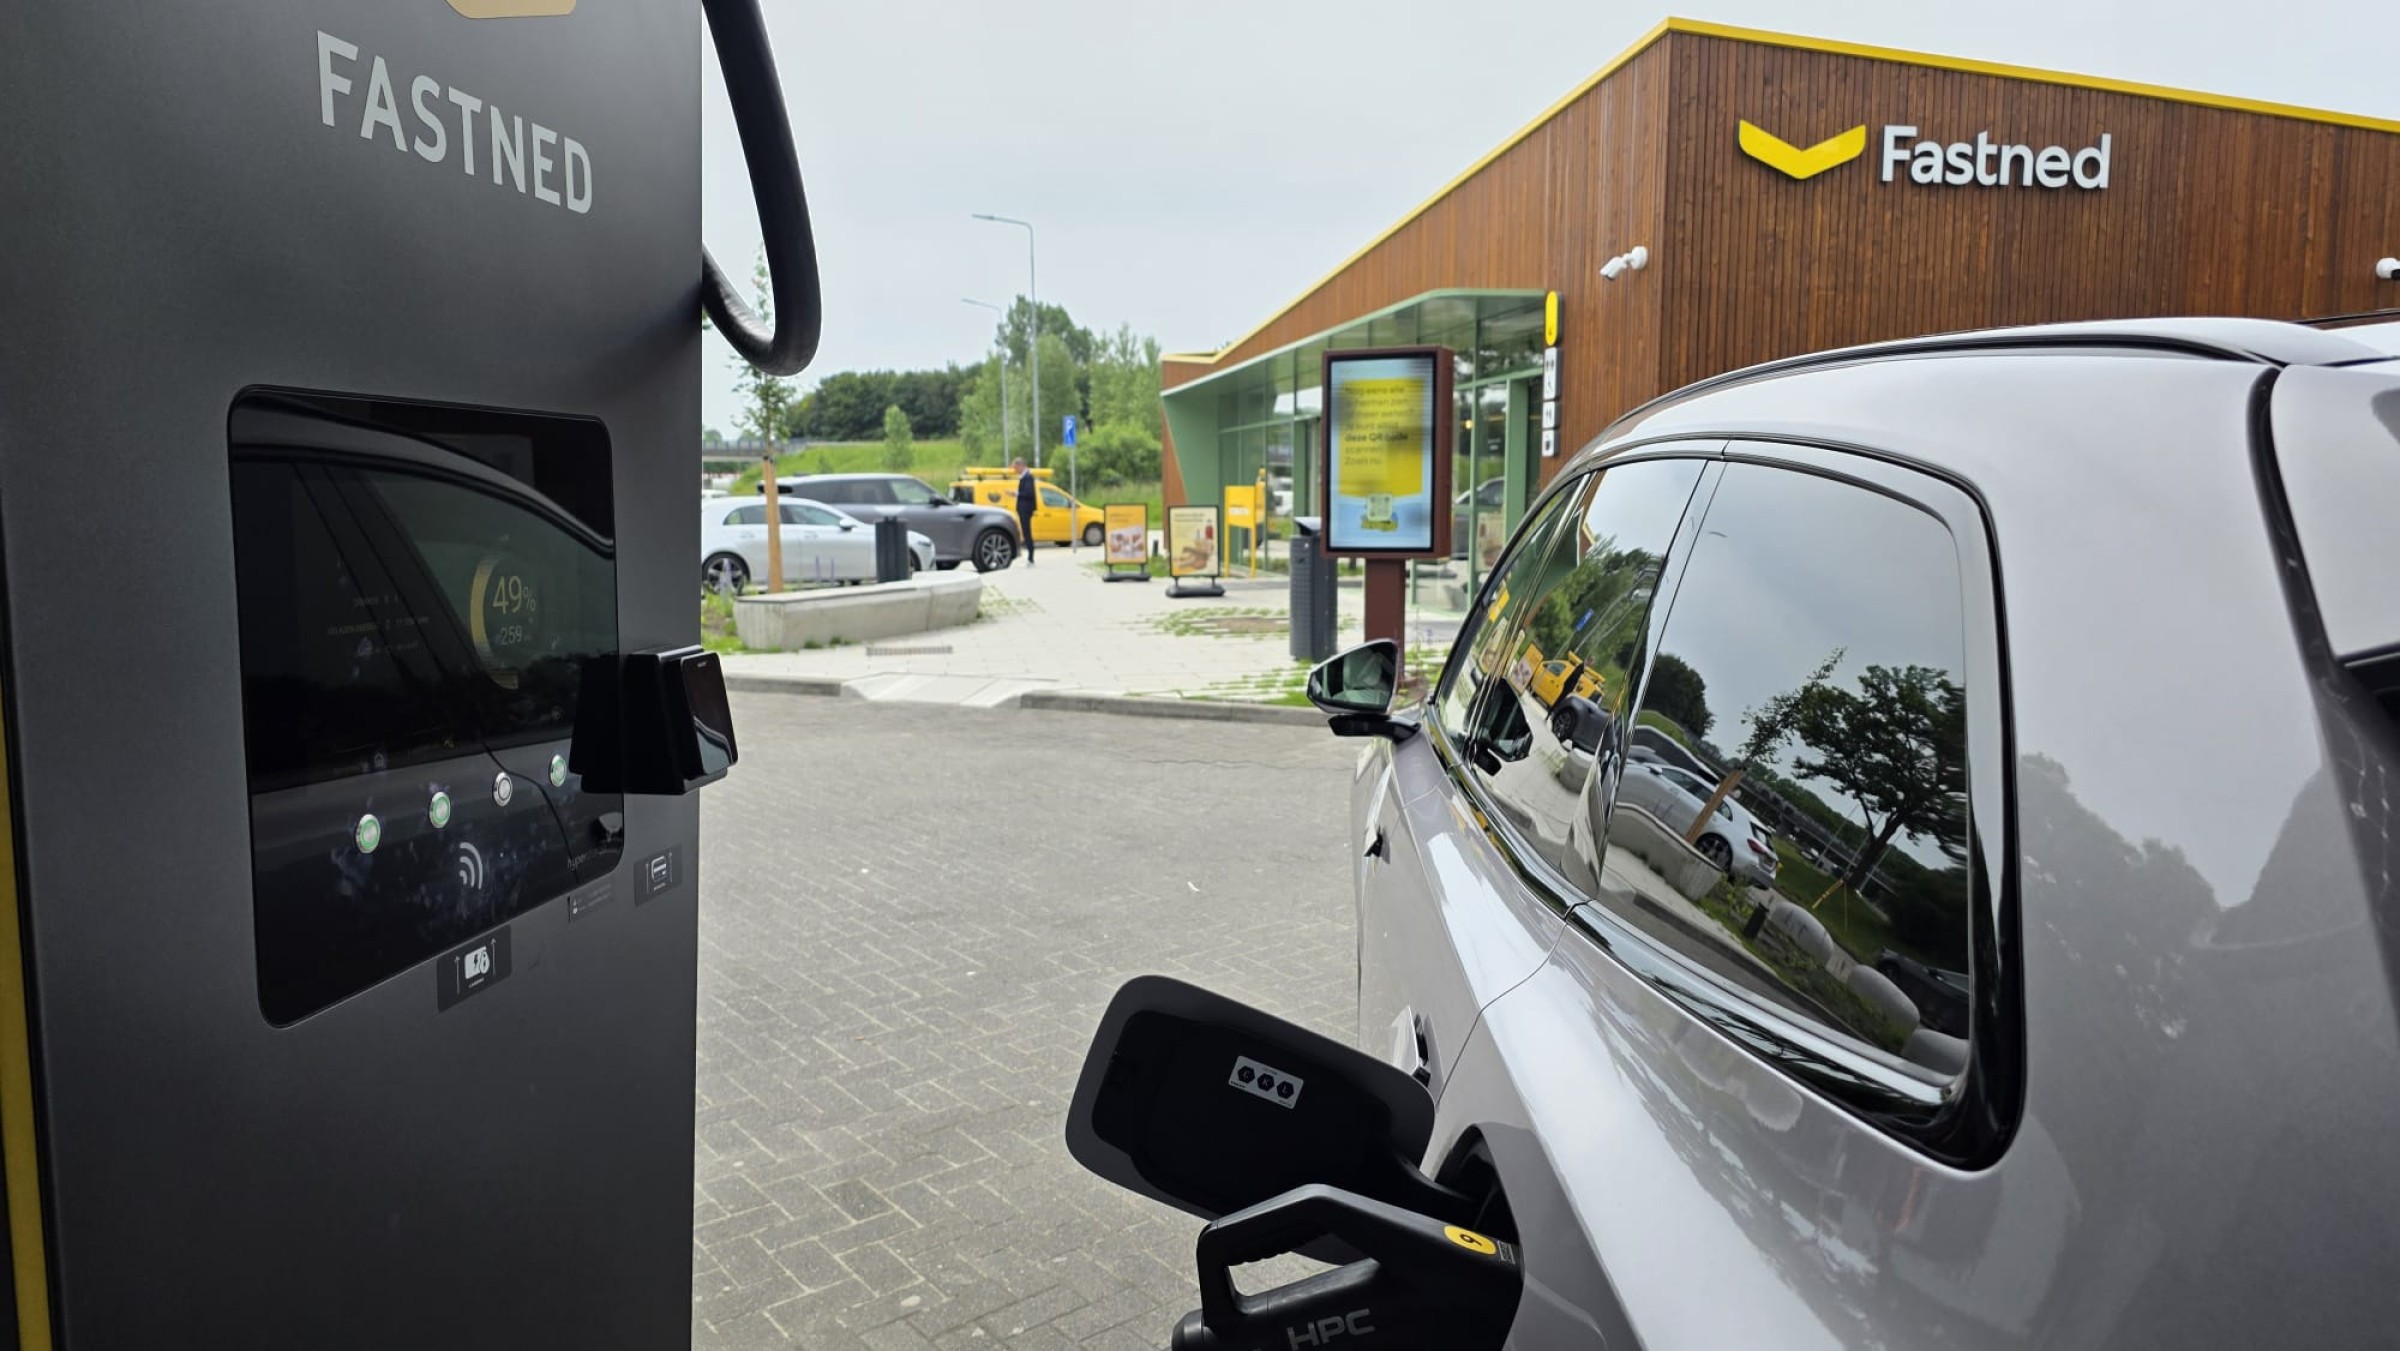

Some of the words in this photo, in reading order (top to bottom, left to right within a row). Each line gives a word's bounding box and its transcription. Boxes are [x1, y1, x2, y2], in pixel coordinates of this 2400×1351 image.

[317, 30, 592, 214] FASTNED
[1881, 125, 2111, 189] Fastned
[1369, 432, 1383, 442] QR
[492, 575, 536, 615] 49%
[500, 624, 523, 645] 259
[1287, 1308, 1376, 1351] HPC
